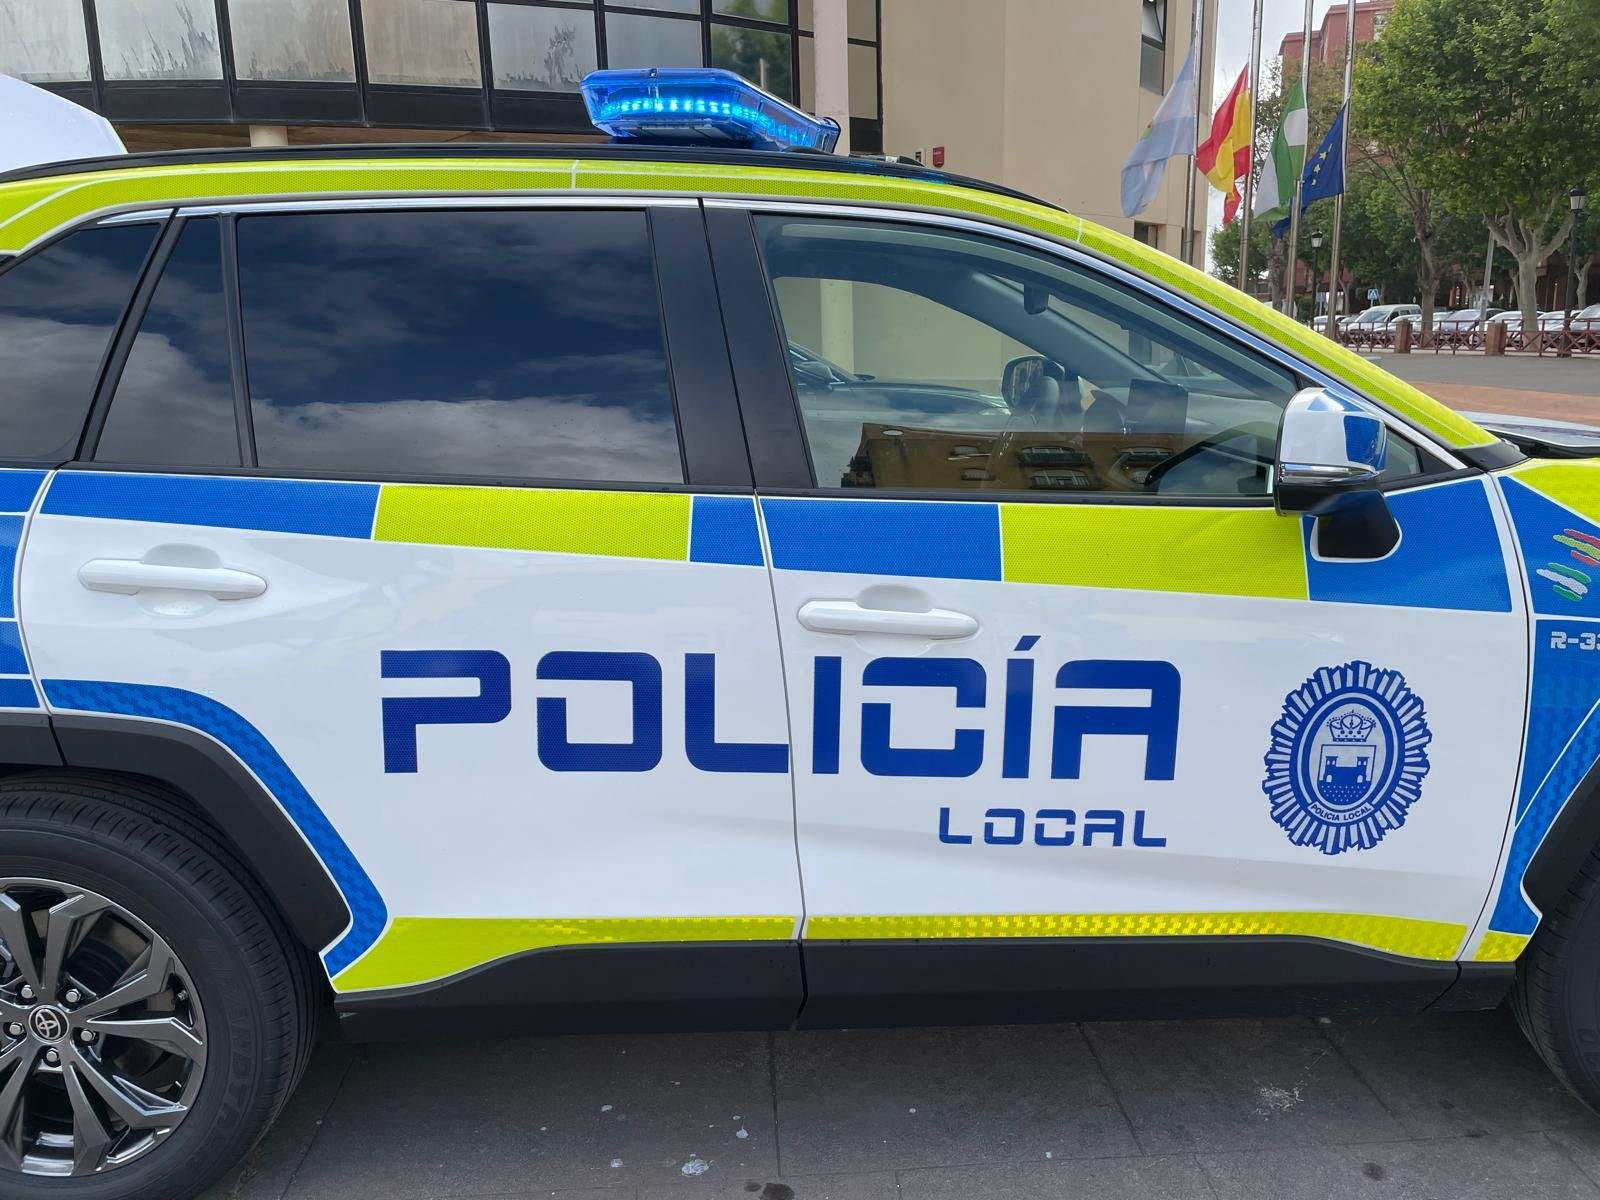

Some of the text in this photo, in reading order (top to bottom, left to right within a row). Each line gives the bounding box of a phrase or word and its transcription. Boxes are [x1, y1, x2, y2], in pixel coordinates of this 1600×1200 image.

[1550, 631, 1600, 651] R-3
[380, 635, 1182, 781] POLICÍA
[938, 807, 1167, 847] LOCAL
[1343, 806, 1371, 821] LOCAL
